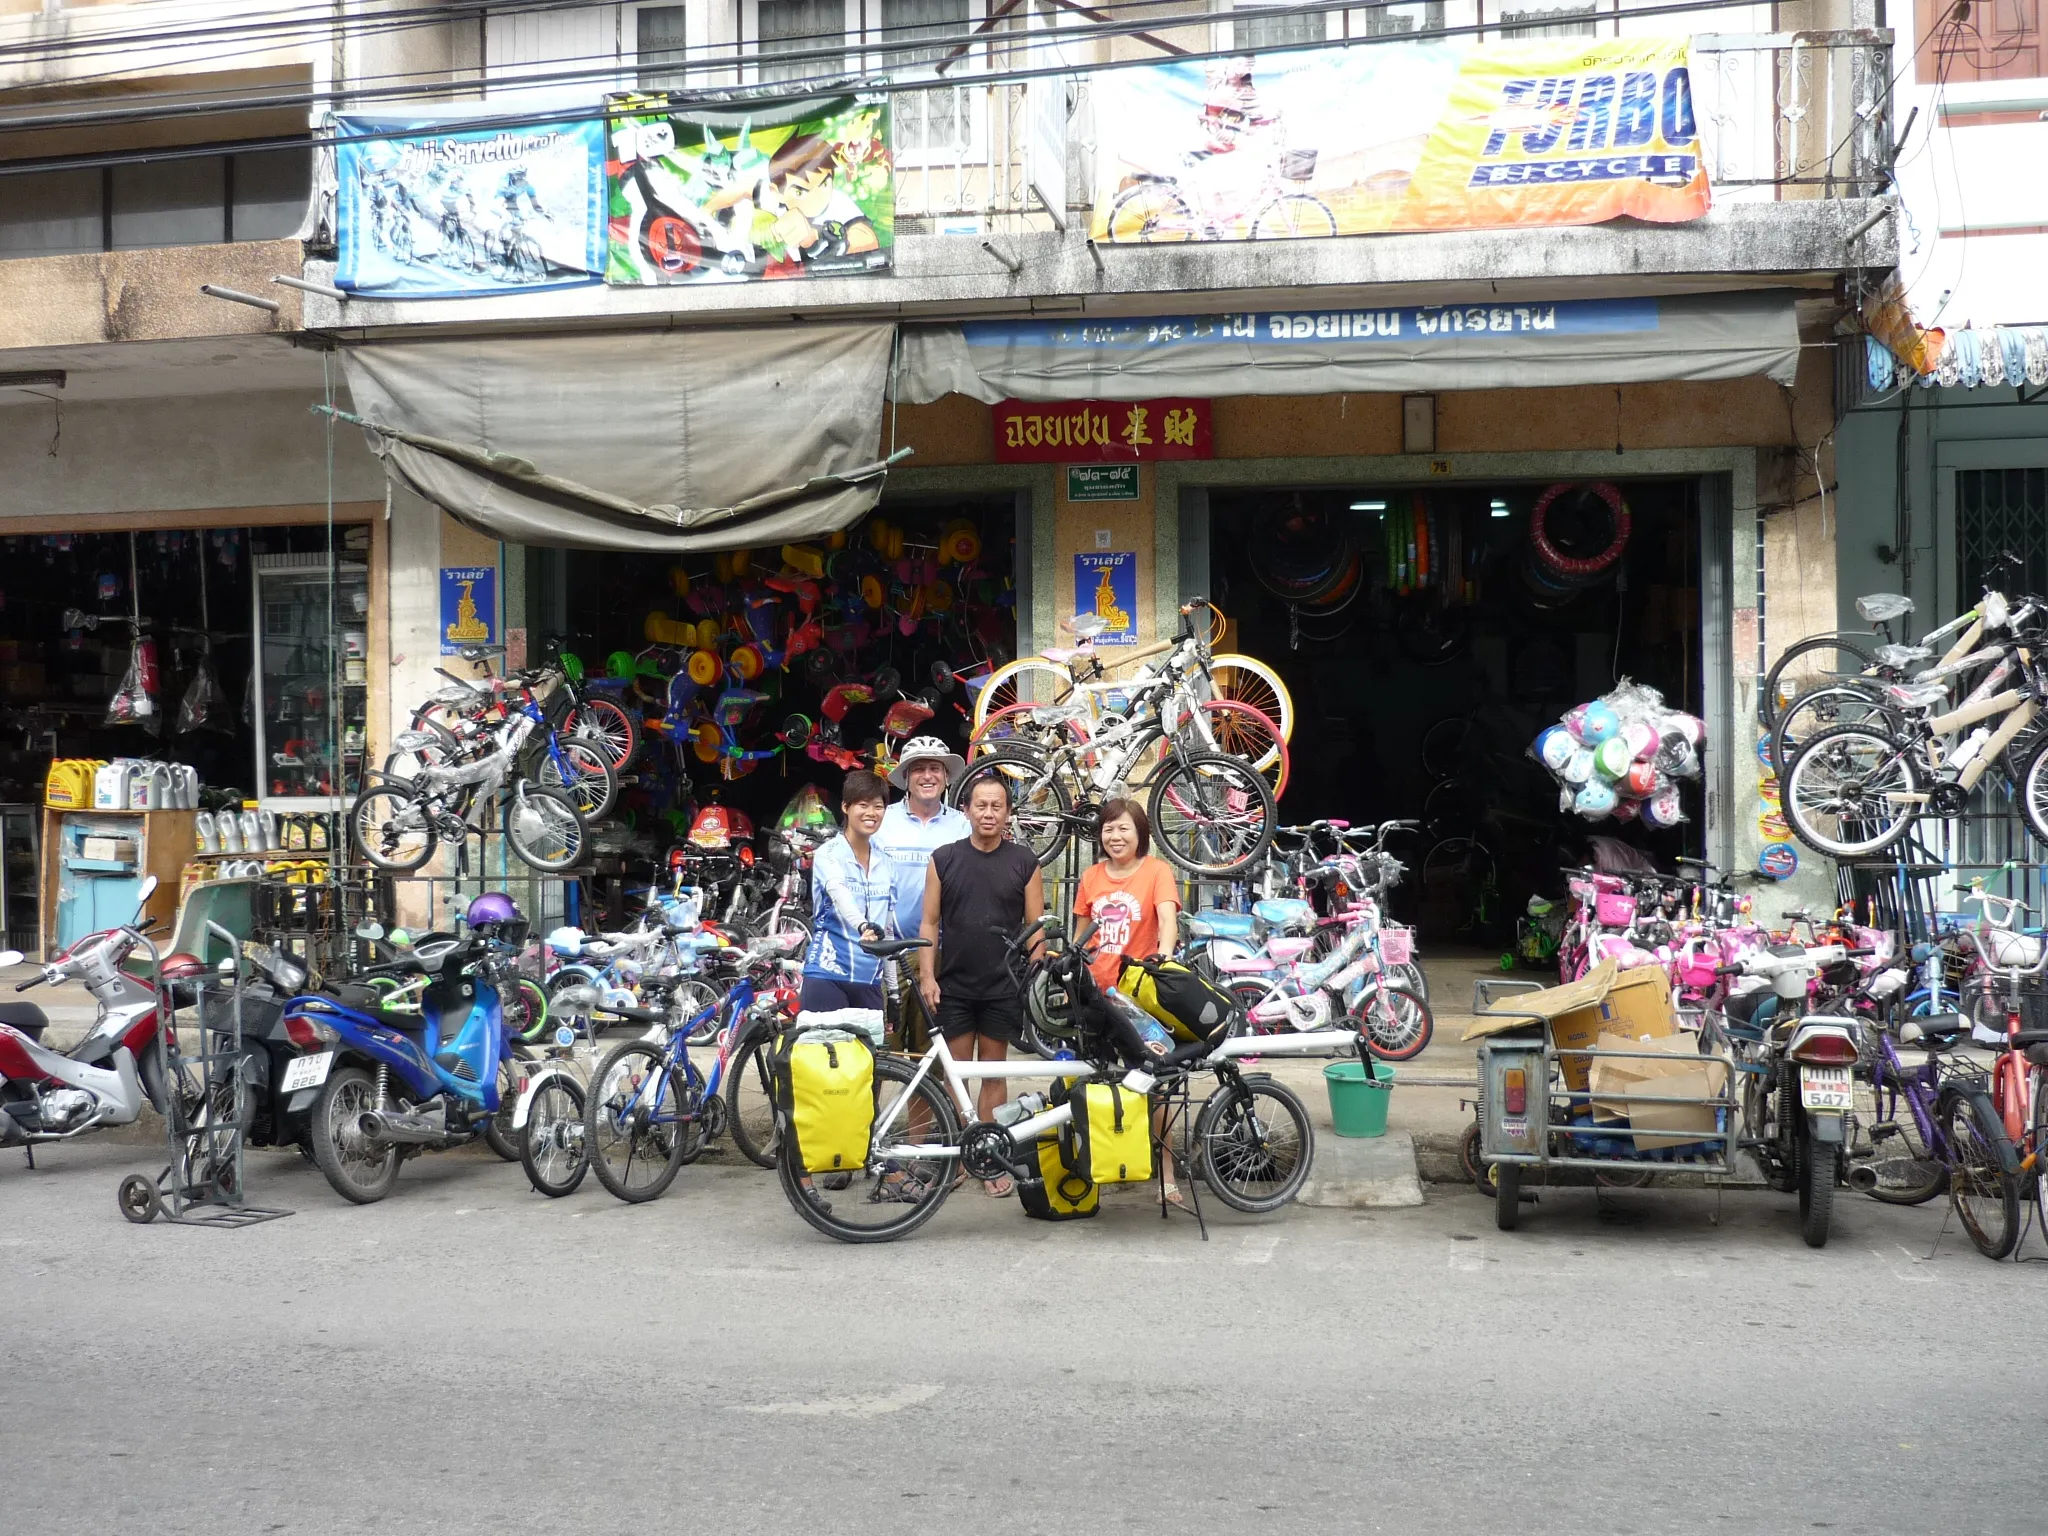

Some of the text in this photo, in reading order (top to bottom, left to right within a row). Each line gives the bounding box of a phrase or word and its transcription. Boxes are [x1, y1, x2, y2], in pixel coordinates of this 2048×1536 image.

[1481, 66, 1697, 156] TURBO
[401, 133, 524, 171] Fuji-Servetto
[1489, 157, 1681, 182] BICYCLE
[449, 628, 488, 638] RALEIGH
[1811, 1093, 1844, 1107] 547
